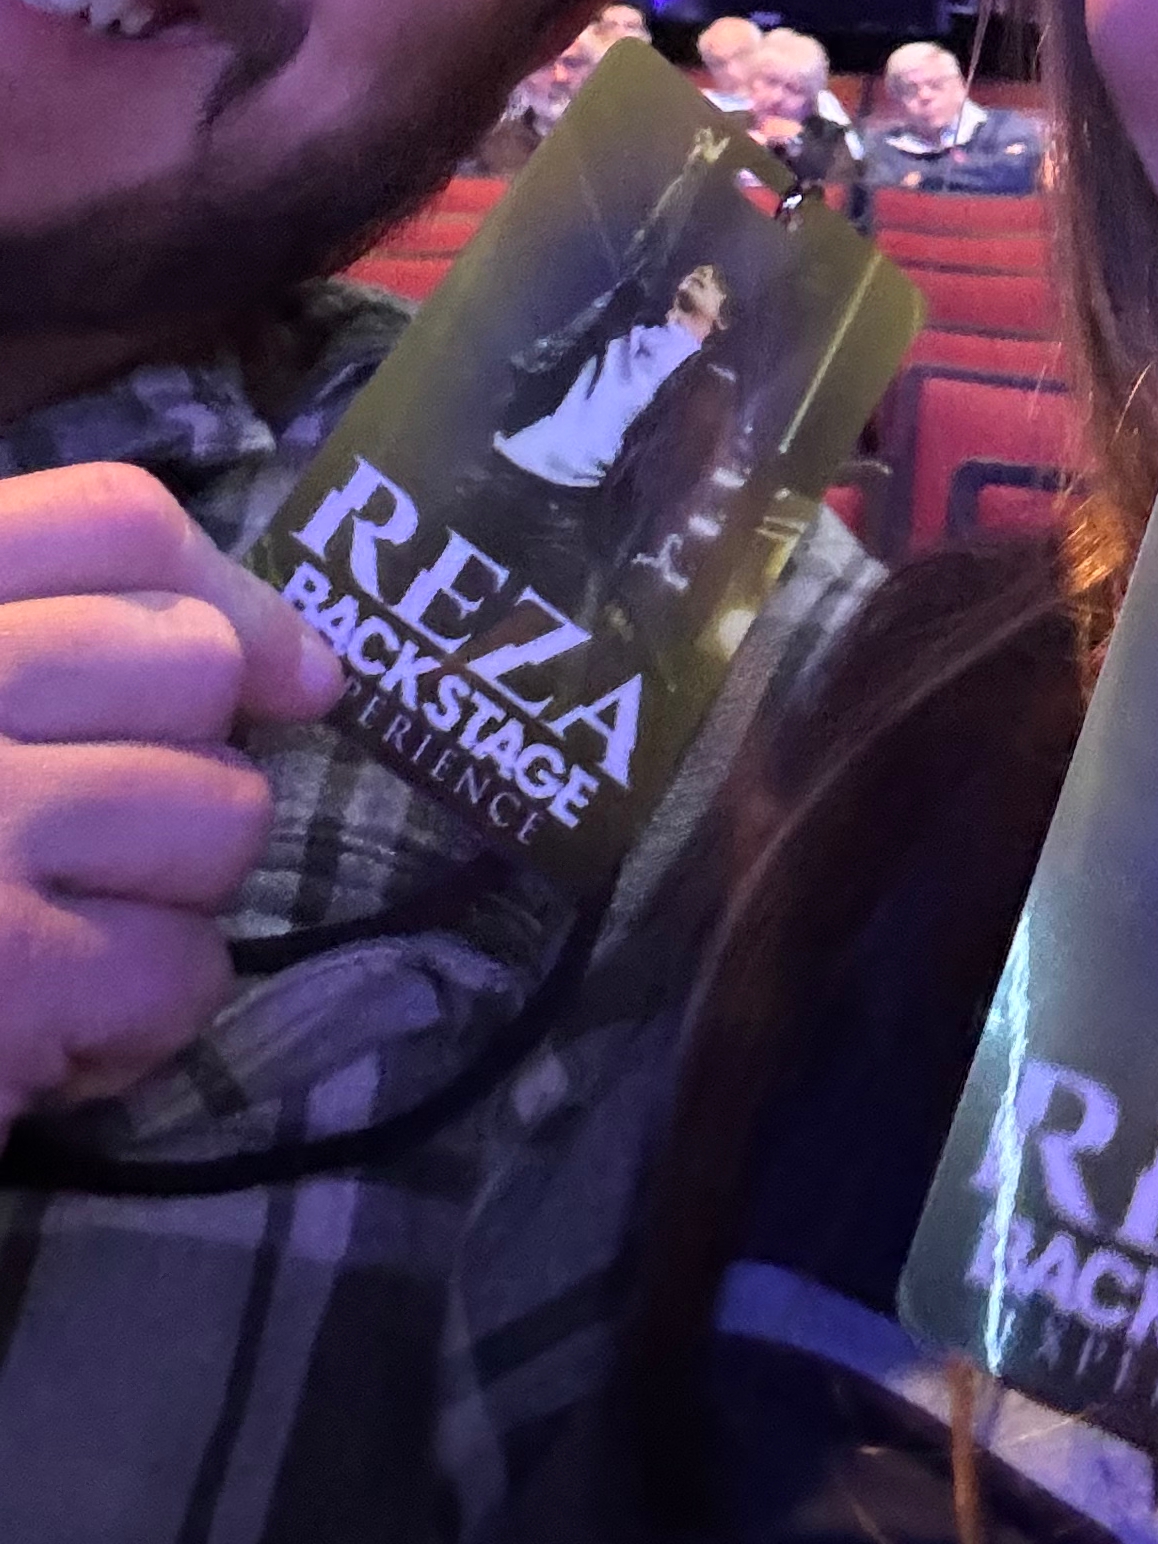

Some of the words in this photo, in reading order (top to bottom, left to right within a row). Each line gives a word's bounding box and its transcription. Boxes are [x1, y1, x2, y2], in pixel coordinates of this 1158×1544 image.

[282, 561, 600, 829] BACKSTAGE
[291, 455, 642, 789] REZA
[343, 673, 546, 847] PERIENCE
